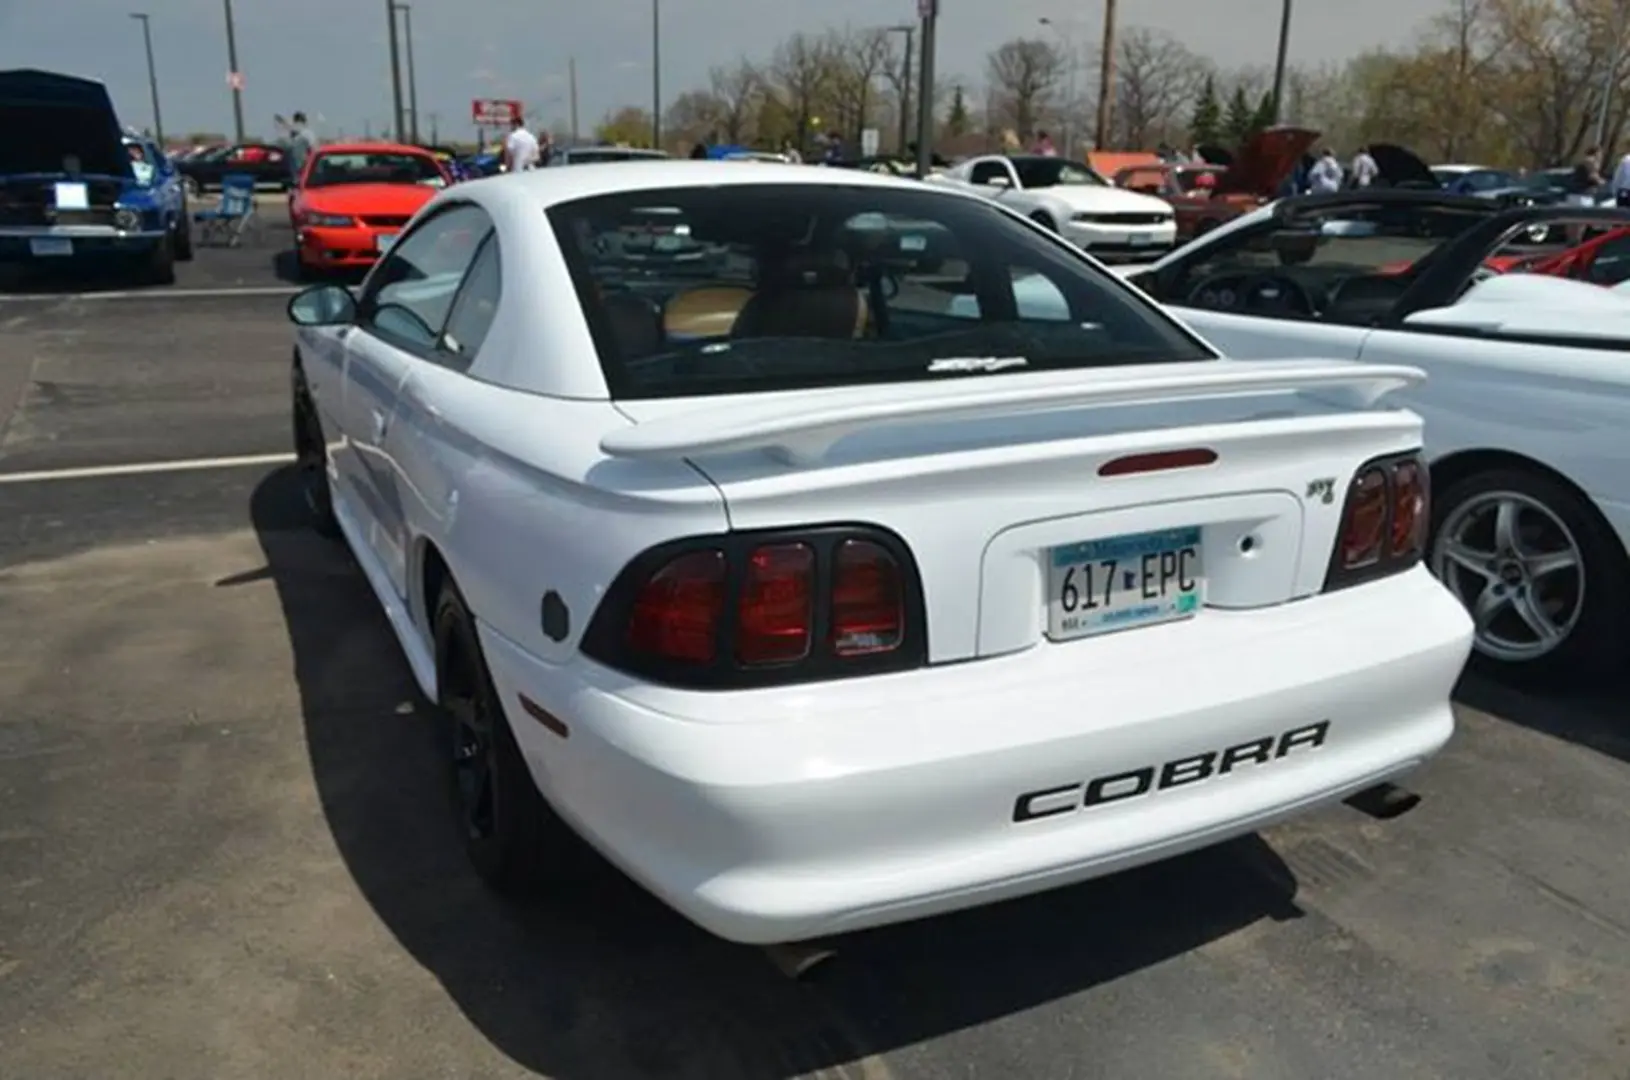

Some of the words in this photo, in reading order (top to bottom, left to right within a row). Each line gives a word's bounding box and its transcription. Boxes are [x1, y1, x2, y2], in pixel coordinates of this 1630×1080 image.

[1061, 559, 1118, 613] 617
[1142, 547, 1196, 600] EPC
[1012, 719, 1331, 823] COBRA
